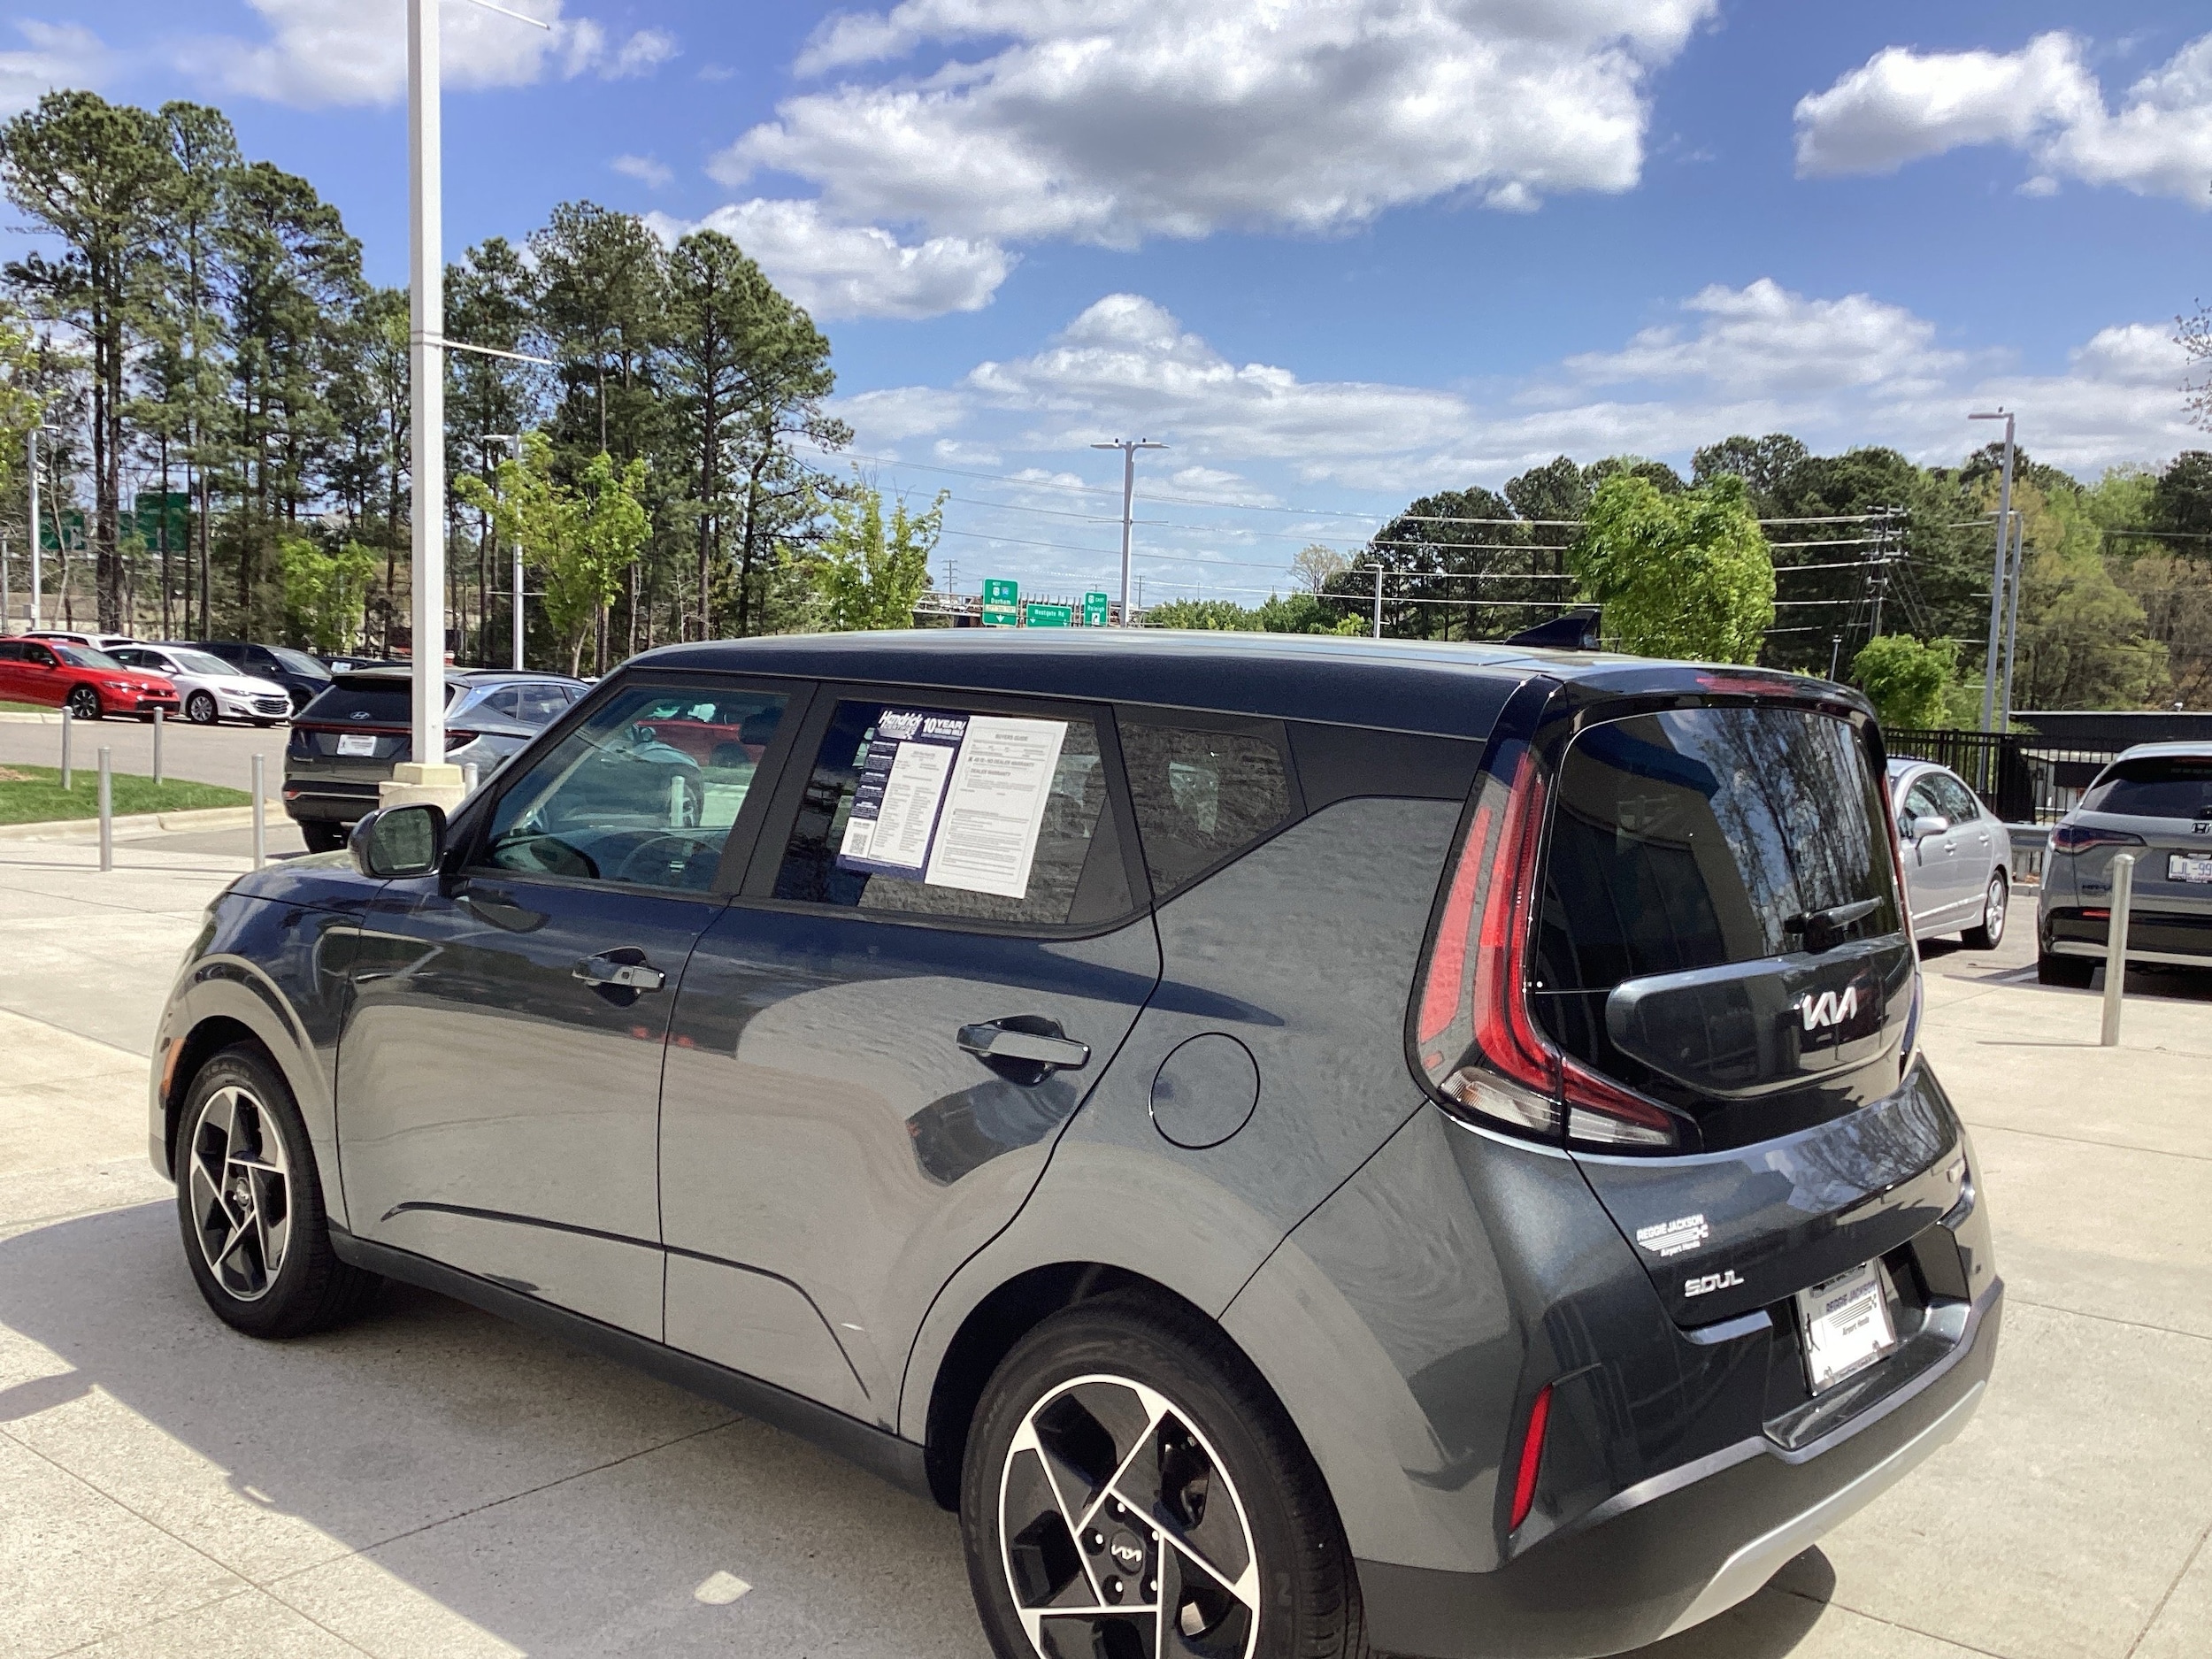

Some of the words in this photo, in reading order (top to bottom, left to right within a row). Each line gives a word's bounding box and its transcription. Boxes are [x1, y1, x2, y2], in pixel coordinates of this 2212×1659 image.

[990, 597, 1011, 606] Durham
[924, 718, 937, 733] 10
[1802, 986, 1857, 1031] KIA
[1637, 1223, 1667, 1241] REGGIE
[1667, 1213, 1704, 1233] JACKSON
[1684, 1270, 1745, 1298] SOUL
[1826, 1293, 1847, 1315] REGGIE
[1848, 1279, 1877, 1303] JACKSON
